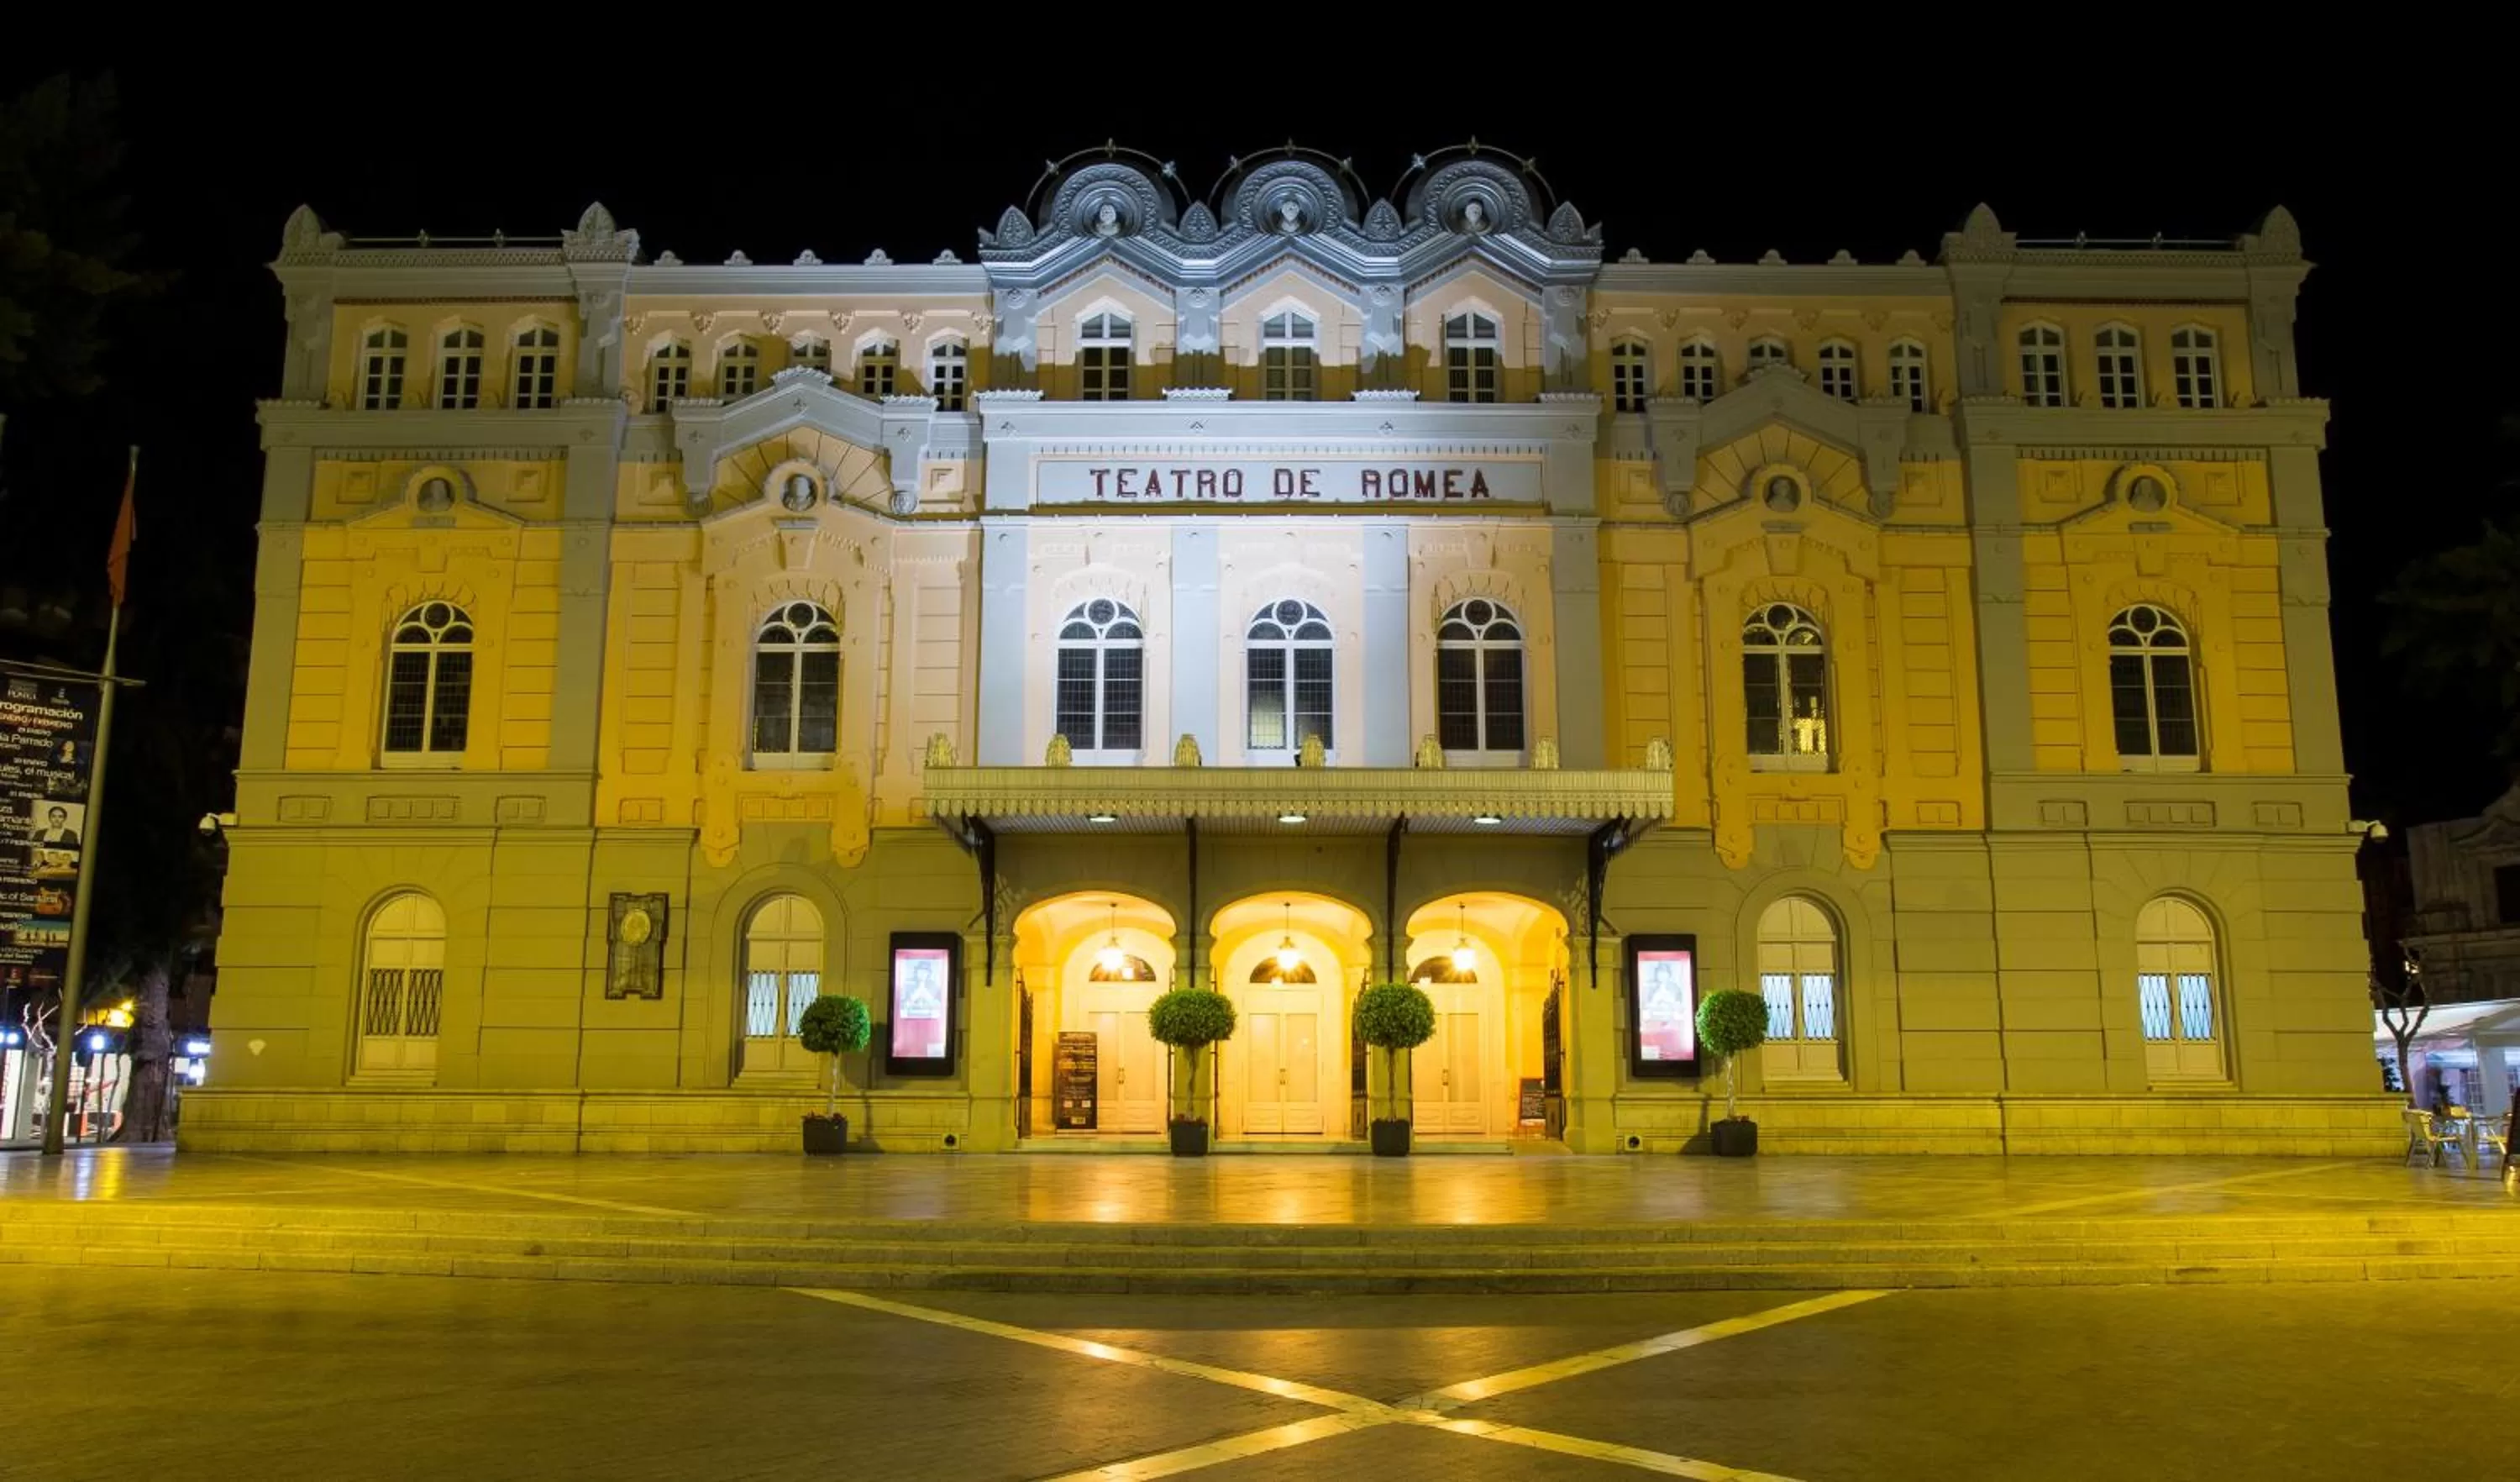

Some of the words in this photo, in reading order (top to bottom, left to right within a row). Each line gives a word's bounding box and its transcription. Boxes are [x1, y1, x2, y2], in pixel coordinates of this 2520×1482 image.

[1089, 468, 1244, 498] TEATRO
[1273, 468, 1321, 498] DE
[1362, 468, 1491, 498] ROMEA
